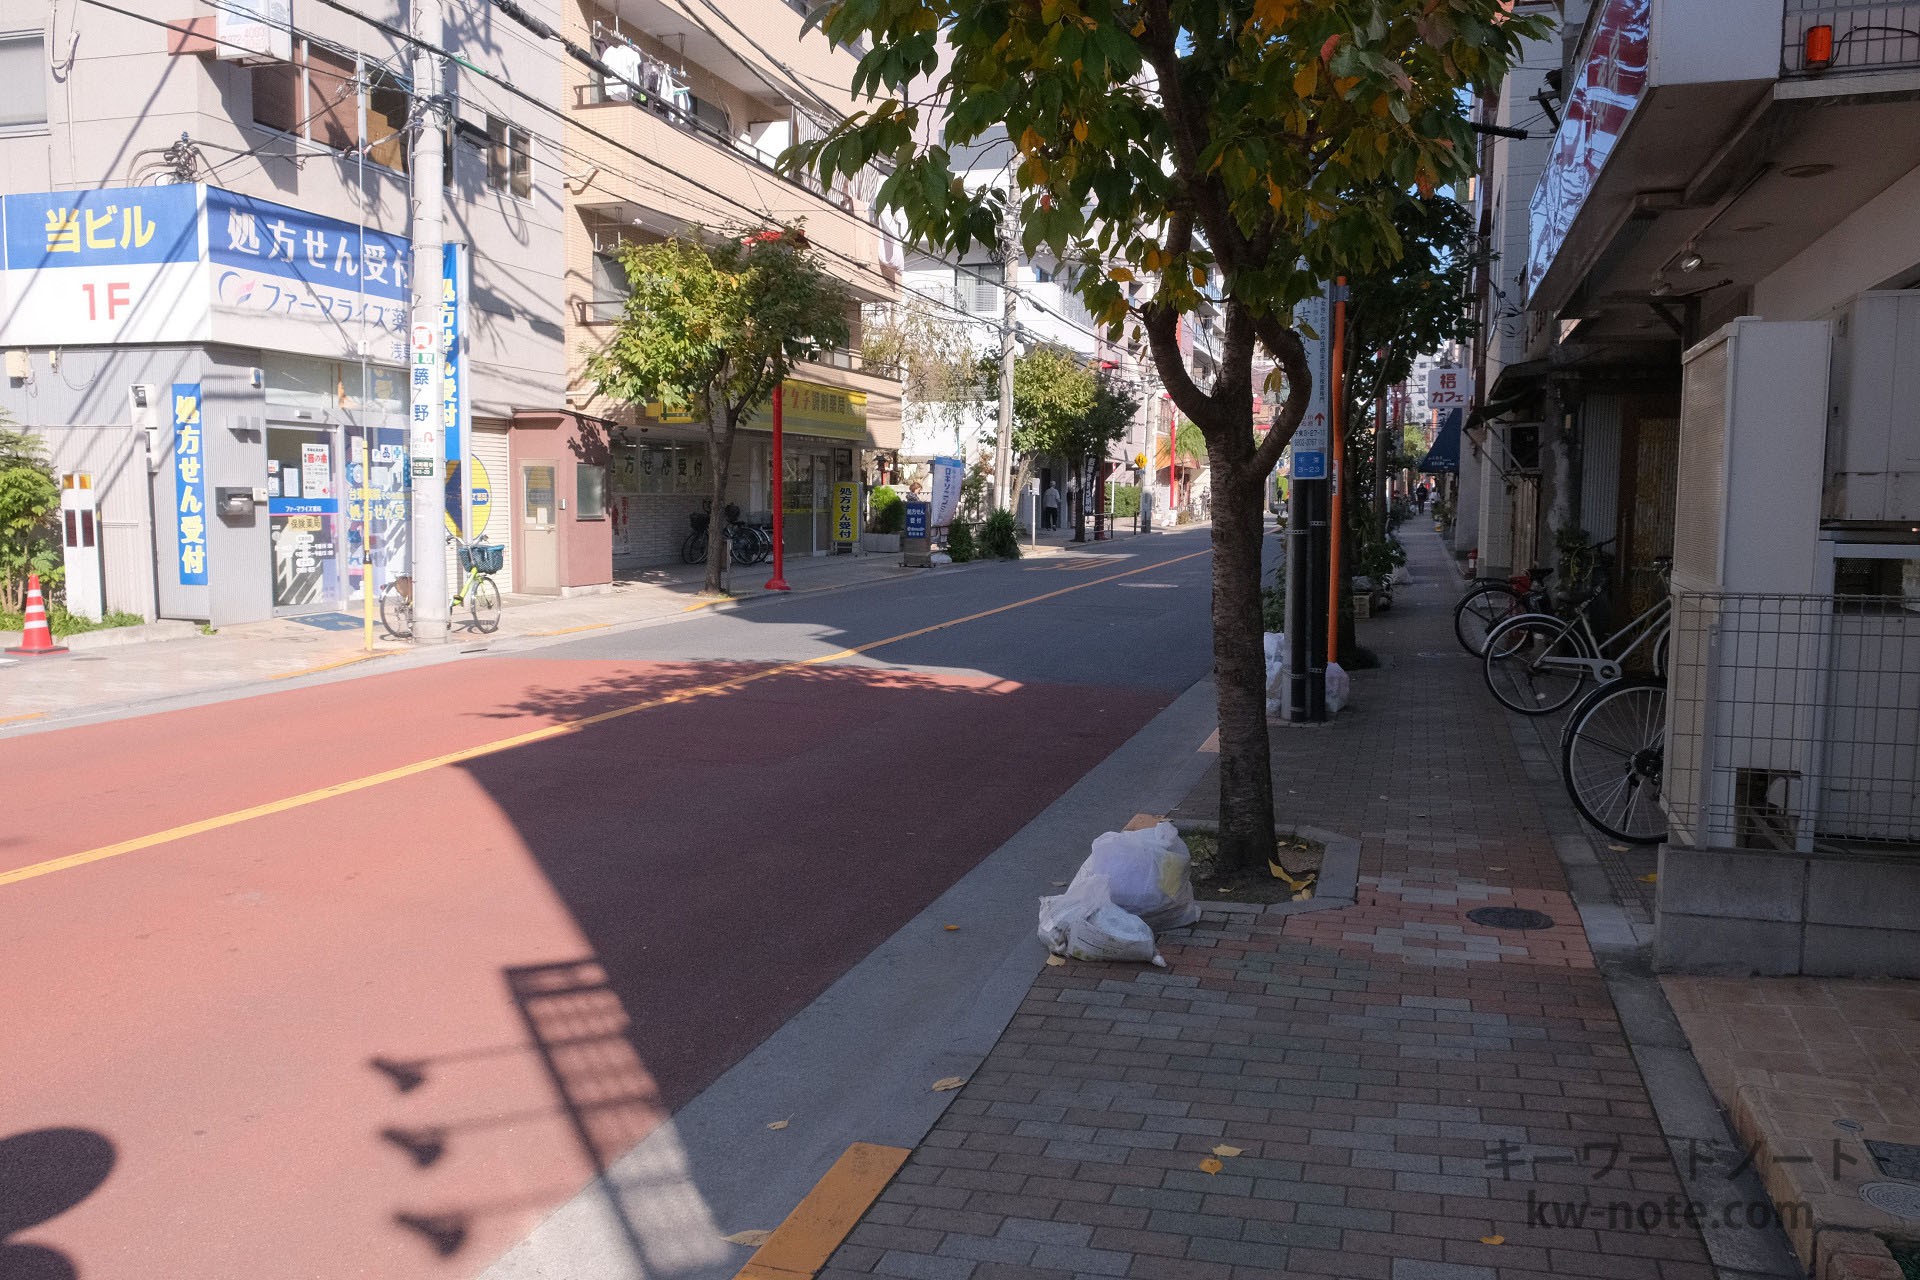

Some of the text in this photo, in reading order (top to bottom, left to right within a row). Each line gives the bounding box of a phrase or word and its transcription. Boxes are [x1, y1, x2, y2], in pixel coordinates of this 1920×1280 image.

[44, 205, 156, 255] 当ビル
[81, 281, 132, 321] 1F
[1432, 391, 1464, 403] カフェ
[175, 395, 206, 575] 処方せん受付
[290, 516, 322, 530] 保険薬局
[839, 487, 852, 539] 処方せん受付
